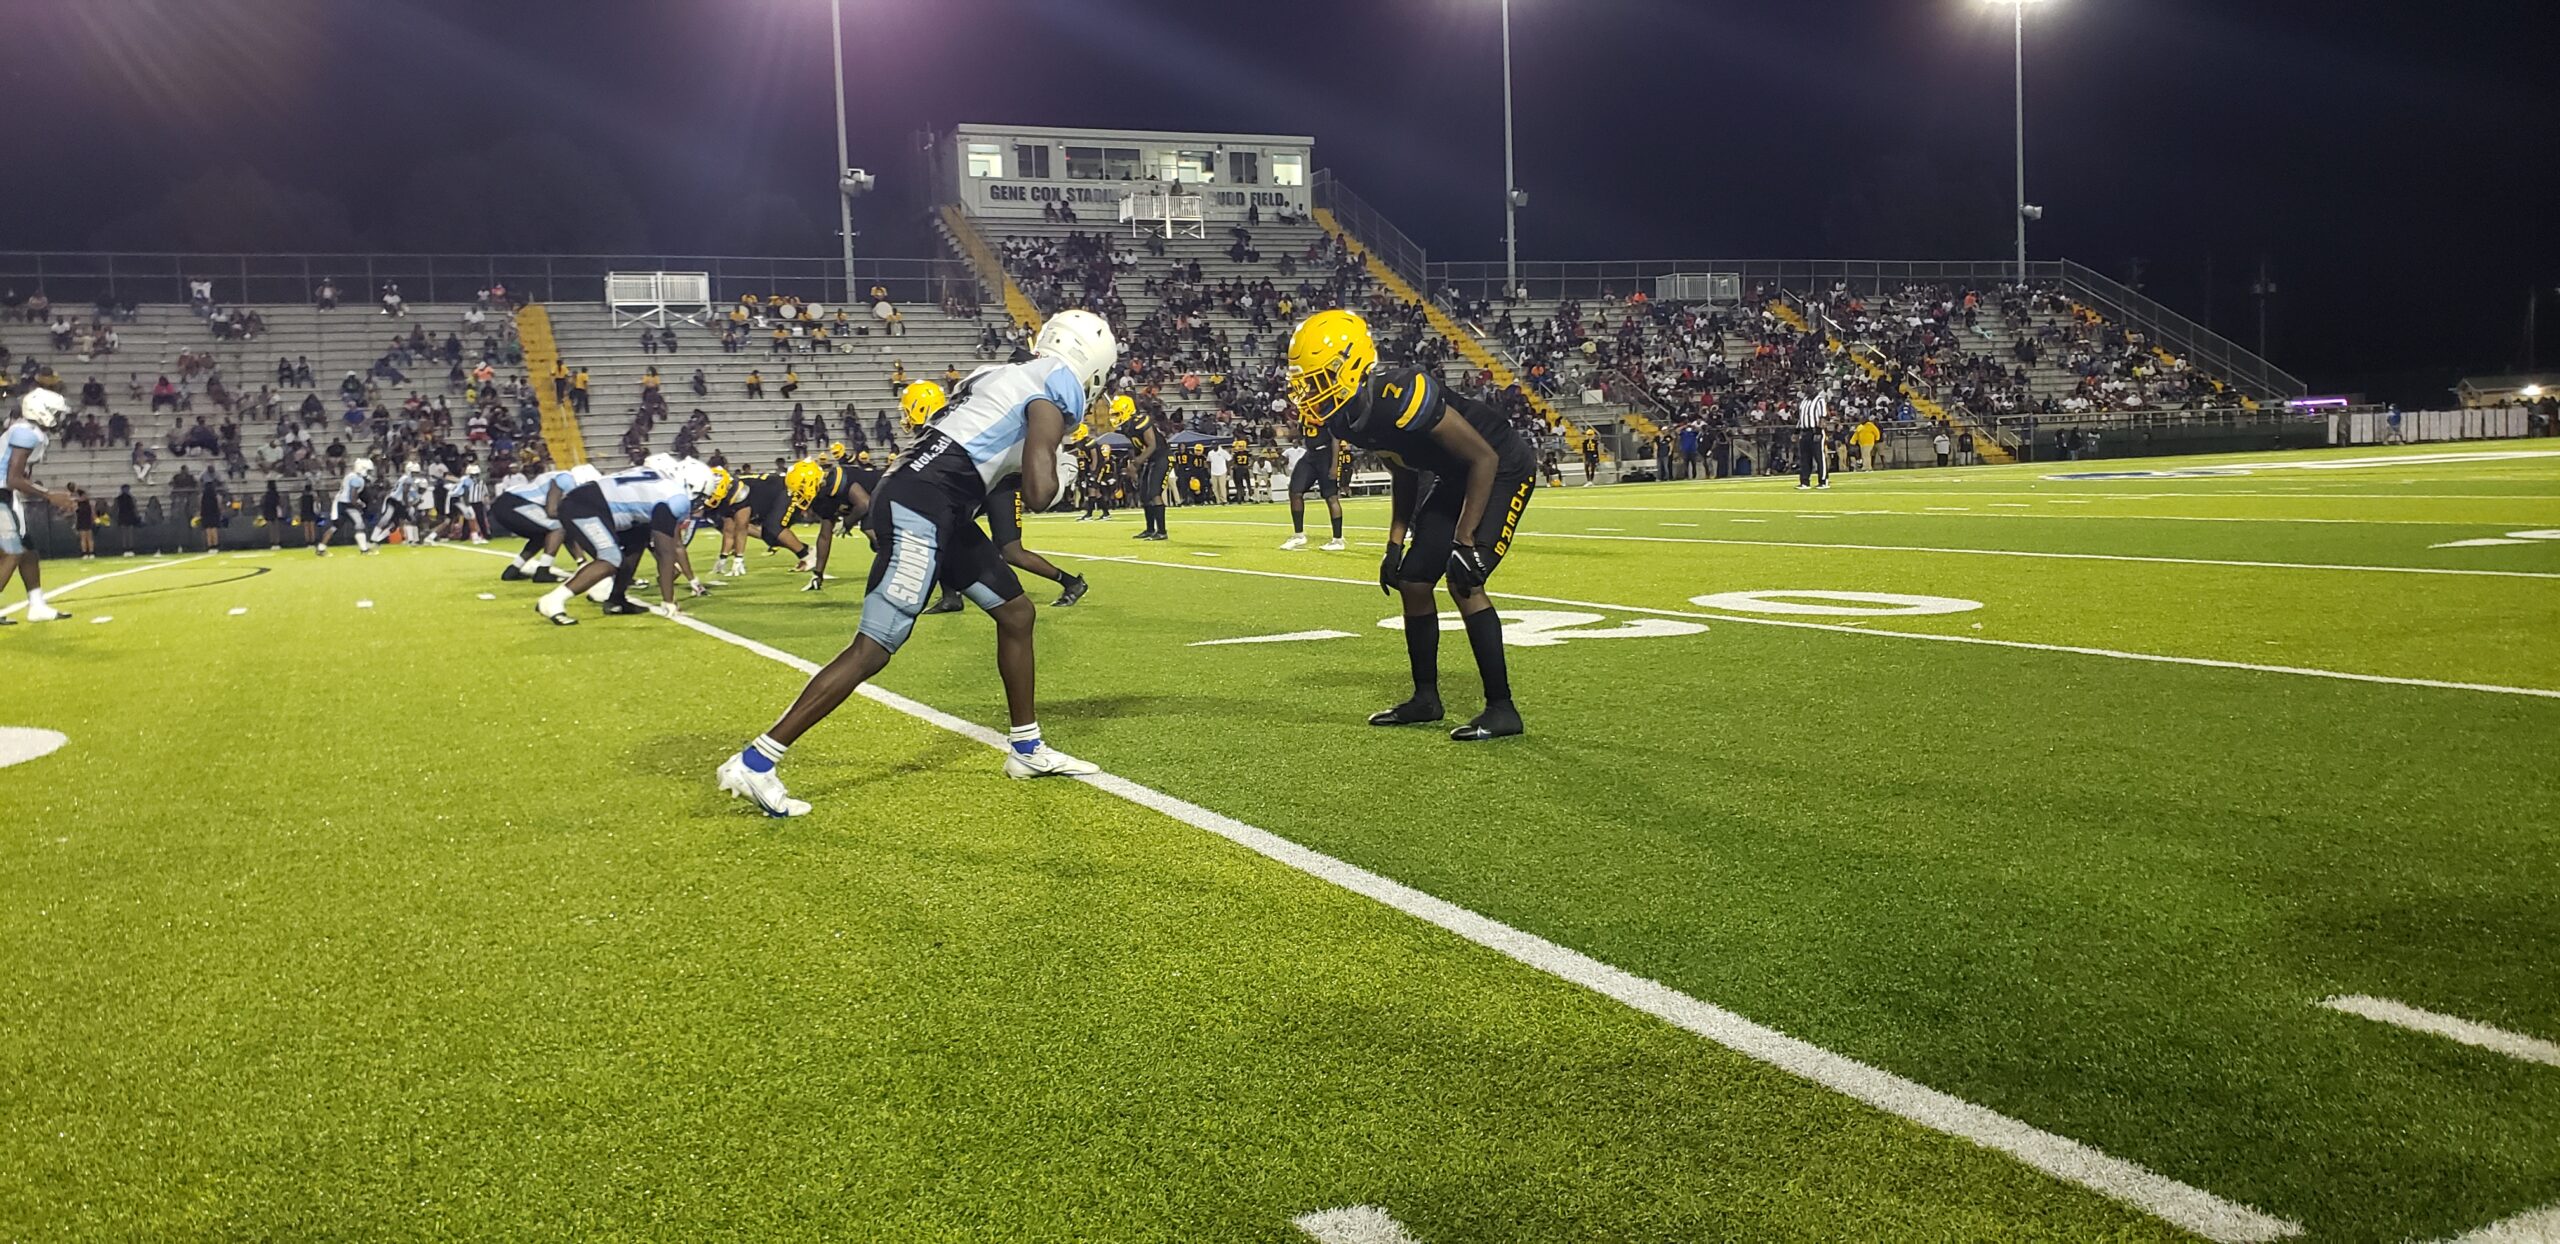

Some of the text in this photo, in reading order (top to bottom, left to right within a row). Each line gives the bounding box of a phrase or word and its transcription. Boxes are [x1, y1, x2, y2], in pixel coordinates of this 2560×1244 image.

[990, 185, 1026, 201] GENE
[1031, 186, 1061, 202] COX
[1066, 187, 1120, 203] STADI
[1250, 191, 1284, 207] FIELD
[1381, 382, 1404, 399] 7
